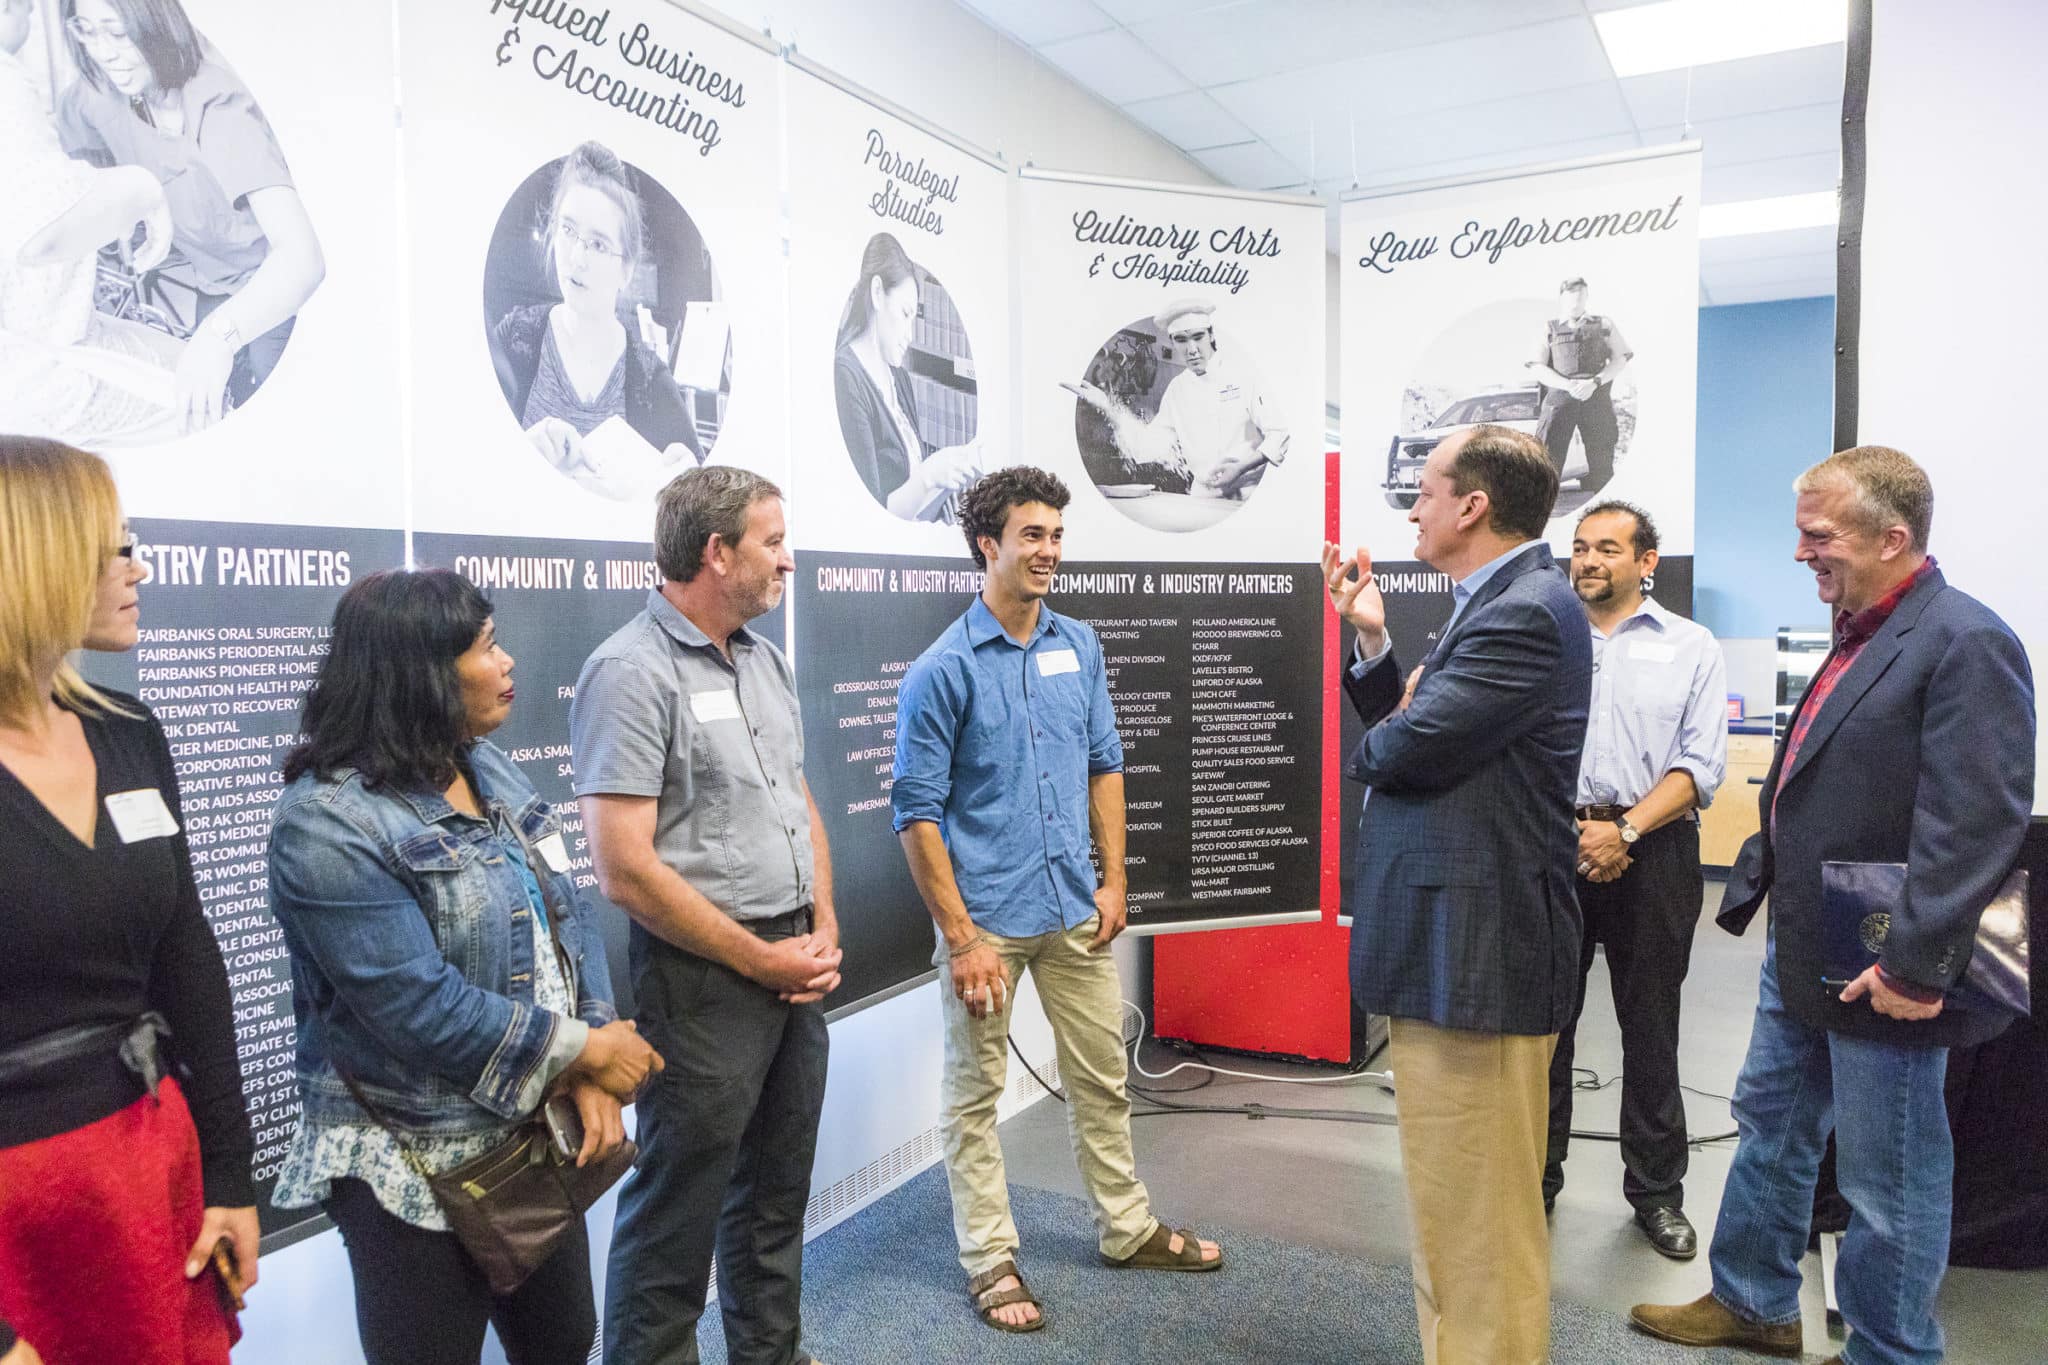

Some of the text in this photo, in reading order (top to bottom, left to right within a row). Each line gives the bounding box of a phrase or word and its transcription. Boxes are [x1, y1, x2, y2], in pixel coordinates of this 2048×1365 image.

[619, 22, 746, 108] Business
[495, 26, 722, 157] & Accounting
[864, 128, 959, 204] Paralegal
[868, 180, 944, 236] Studies
[1073, 209, 1281, 260] Culinary Arts
[1359, 195, 1683, 274] Law Enforcement
[1089, 252, 1249, 294] & Hospitality
[217, 548, 351, 587] PARTNERS
[583, 560, 599, 590] &
[606, 560, 665, 590] INDUST
[818, 567, 884, 593] COMMUNITY
[889, 569, 898, 593] &
[902, 569, 946, 593] INDUSTRY
[1050, 573, 1293, 595] COMMUNITY & INDUSTRY PARTNERS
[1130, 618, 1148, 627] AND
[1148, 618, 1178, 627] TAVERN
[1192, 617, 1277, 627] HOLLAND AMERICA LINE
[137, 628, 215, 643] FAIRBANKS
[218, 628, 254, 641] ORAL
[256, 627, 316, 641] SURGERY,
[1100, 631, 1140, 639] ROASTING
[1192, 630, 1283, 639] HOODOO BREWERING CO.
[1192, 642, 1219, 651] ICHARR
[137, 647, 216, 662] FAIRBANKS
[219, 645, 308, 659] PERIODENTAL
[1107, 655, 1166, 664] LINEN DIVISION
[138, 662, 318, 682] FAIRBANKS PIONEER HOME
[880, 661, 906, 673] ALASKA
[1192, 666, 1254, 675] LAVELLE'S BISTRO
[833, 680, 880, 694] CROSSROADS
[1192, 677, 1263, 687] LINFORD OF ALASKA
[139, 684, 234, 701] FOUNDATION
[237, 682, 287, 696] HEALTH
[1142, 691, 1172, 700] CENTER
[1192, 690, 1237, 699] LUNCH CAFE
[210, 702, 230, 715] TO
[233, 699, 300, 714] RECOVERY
[1120, 704, 1157, 713] PRODUCE
[1192, 701, 1275, 711] MAMMOTH MARKETING
[839, 714, 873, 729] DOWNES,
[1123, 716, 1173, 725] GROSECLOSE
[1192, 712, 1294, 723] PIKE'S WATERFRONT LODGE &
[187, 720, 240, 737] DENTAL
[1135, 728, 1160, 737] & DELI
[1201, 721, 1277, 732] CONFERENCE CENTER
[204, 737, 273, 754] MEDICINE,
[275, 734, 297, 747] DR.
[1192, 733, 1272, 744] PRINCESS CRUISE LINES
[847, 745, 891, 762] LAW OFFICES
[1192, 744, 1285, 756] PUMP HOUSE RESTAURANT
[1125, 764, 1162, 774] HOSPITAL
[1192, 756, 1295, 769] QUALITY SALES FOOD SERVICE
[235, 772, 266, 787] PAIN
[1192, 771, 1226, 780] SAFEWAY
[1192, 780, 1271, 792] SAN ZANOBI CATERING
[211, 793, 244, 809] AIDS
[1192, 792, 1264, 804] SEOUL GATE MARKET
[1128, 801, 1163, 810] MUSEUM
[1192, 803, 1286, 816] SPENARD BUILDERS SUPPLY
[212, 812, 233, 828] AK
[1192, 818, 1233, 828] STICK BUILT
[1191, 826, 1293, 840] SUPERIOR COFFEE OF ALASKA
[1191, 837, 1309, 852] SYSCO FOOD SERVICES OF ALASKA
[1191, 851, 1259, 864] TVTV (CHANNEL 13)
[1191, 862, 1275, 876] URSA MAJOR DISTILLING
[1191, 877, 1230, 888] WAL-MART
[200, 881, 247, 901] CLINIC,
[1126, 891, 1165, 901] COMPANY
[1191, 886, 1272, 900] WESTMARK FAIRBANKS
[215, 895, 269, 917] DENTAL
[1129, 905, 1143, 913] CO.
[214, 914, 270, 937] DENTAL,
